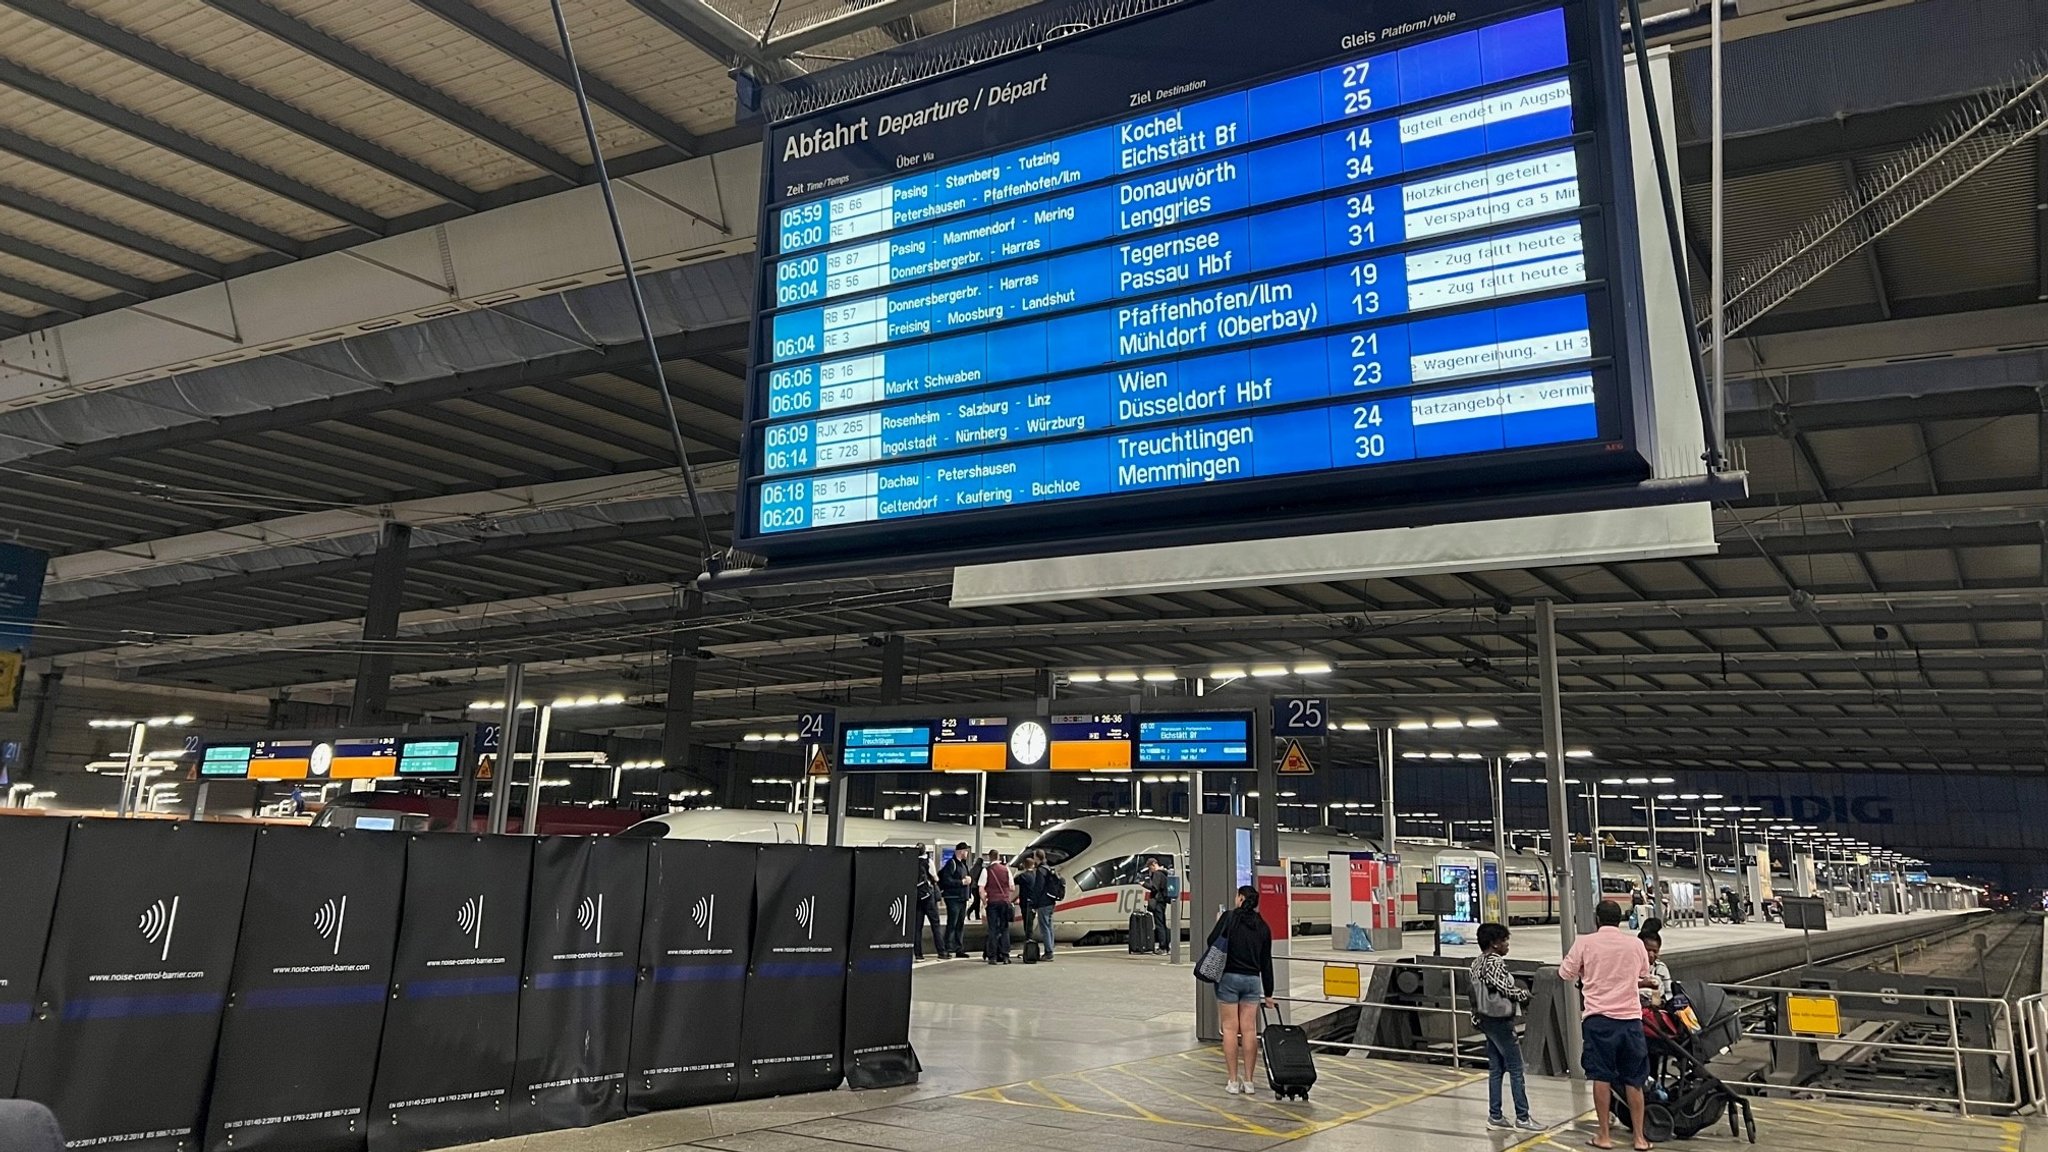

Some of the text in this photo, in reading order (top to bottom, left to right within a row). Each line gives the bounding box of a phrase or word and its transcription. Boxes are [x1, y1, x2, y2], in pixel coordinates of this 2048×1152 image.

[1341, 11, 1457, 50] Gleis Platform/Voie
[1342, 62, 1370, 88] 27
[1130, 79, 1207, 108] Ziel Destination
[1344, 89, 1372, 115] 25
[783, 72, 1048, 162] Abfahrt Departure Départ
[1121, 111, 1184, 146] Kochel
[1402, 117, 1443, 136] ugteil
[1450, 106, 1493, 125] endet
[1500, 101, 1513, 113] in
[1122, 122, 1237, 170] Eichstätt Bf
[1346, 127, 1372, 152] 14
[896, 152, 935, 169] Über Via
[1346, 155, 1374, 180] 34
[787, 174, 850, 198] Zeit Time/Temps
[894, 151, 1060, 202] Pasing Starnberg Tutzing
[1120, 161, 1236, 205] Donauwörth
[1405, 162, 1550, 203] Holzkirchen geteilt
[831, 197, 863, 215] RB 66
[894, 170, 1081, 223] Petershausen Pfaffenhofen/Ilm
[1347, 194, 1375, 219] 34
[1516, 195, 1534, 209] ca
[1540, 191, 1549, 204] 5
[783, 204, 822, 230] 05:59
[1120, 195, 1211, 230] Lenggries
[783, 225, 822, 250] 06:00
[831, 221, 856, 237] RE 1
[891, 206, 1075, 257] Pasing Mammendorf Mering
[1348, 221, 1375, 247] 31
[828, 252, 859, 269] RB 87
[891, 237, 1041, 280] Donnersbergerbr. Harras
[1120, 231, 1220, 267] Tegernsee
[1445, 252, 1472, 267] Zug
[1518, 233, 1566, 253] heute
[780, 258, 819, 282] 06:00
[1120, 251, 1233, 291] Passau Hbf
[1350, 262, 1378, 288] 19
[1448, 281, 1474, 297] Zug
[1521, 263, 1569, 282] heute
[779, 280, 818, 303] 06:04
[828, 275, 859, 291] RB 56
[889, 273, 1039, 313] Donnersbergerbr. Harras
[825, 307, 857, 324] RB 57
[888, 288, 1076, 337] Freising Moosburg Landshut
[1119, 282, 1293, 330] Pfaffenhofen/Ilm
[1352, 291, 1380, 316] 13
[825, 331, 850, 347] RE 3
[1119, 302, 1318, 356] Mühldorf (Oberbay)
[776, 335, 815, 358] 06:04
[1350, 333, 1378, 358] 21
[1424, 336, 1589, 370] Wagenreihung. LH 3
[773, 368, 812, 391] 06:06
[821, 364, 854, 381] RB 16
[886, 368, 981, 395] Markt Schwaben
[1118, 370, 1167, 393] Wien
[1352, 361, 1382, 387] 23
[772, 391, 811, 414] 06:06
[821, 387, 854, 403] RB 40
[1119, 378, 1272, 420] Düsseldorf Hbf
[1412, 393, 1513, 417] Platzangebot
[882, 393, 1051, 430] Rosenheim Salzburg Linz
[1353, 405, 1382, 430] 24
[768, 425, 808, 448] 06:09
[817, 420, 863, 438] RJX 265
[882, 415, 1085, 455] Ingolstadt Nürnberg Würzburg
[838, 444, 859, 458] 728
[1118, 426, 1254, 459] Treuchtlingen
[1355, 434, 1385, 459] 30
[767, 448, 808, 470] 06:14
[1118, 455, 1240, 486] Memmingen
[813, 480, 847, 496] RB 16
[879, 461, 1016, 490] Dachau Petershausen
[764, 483, 804, 506] 06:18
[879, 480, 1081, 514] Geltendorf Kaufering Buchloe
[763, 506, 804, 529] 06:20
[813, 504, 846, 520] RE 72
[801, 714, 823, 737] 24
[1289, 700, 1321, 727] 25
[184, 736, 199, 752] 22
[484, 726, 500, 746] 23
[1118, 890, 1143, 913] ICE
[89, 969, 204, 982] www.noise-control-barrier.com
[272, 962, 370, 974] www.noise-control-barrier.com
